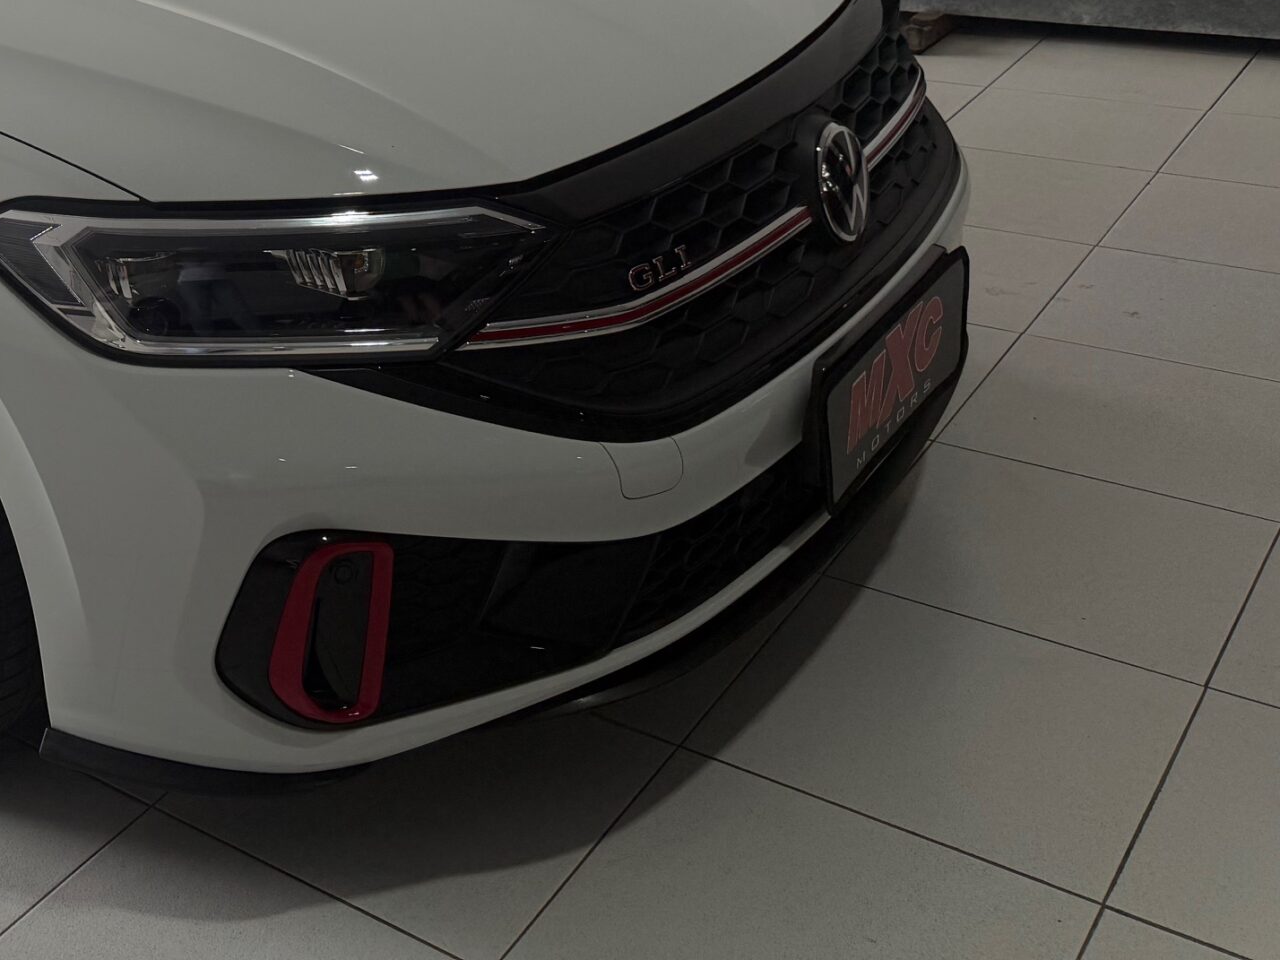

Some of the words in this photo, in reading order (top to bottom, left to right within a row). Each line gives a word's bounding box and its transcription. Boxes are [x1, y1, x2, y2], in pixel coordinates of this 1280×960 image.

[628, 245, 692, 291] GLI
[847, 296, 943, 455] MXC
[856, 378, 932, 470] MOTORS
